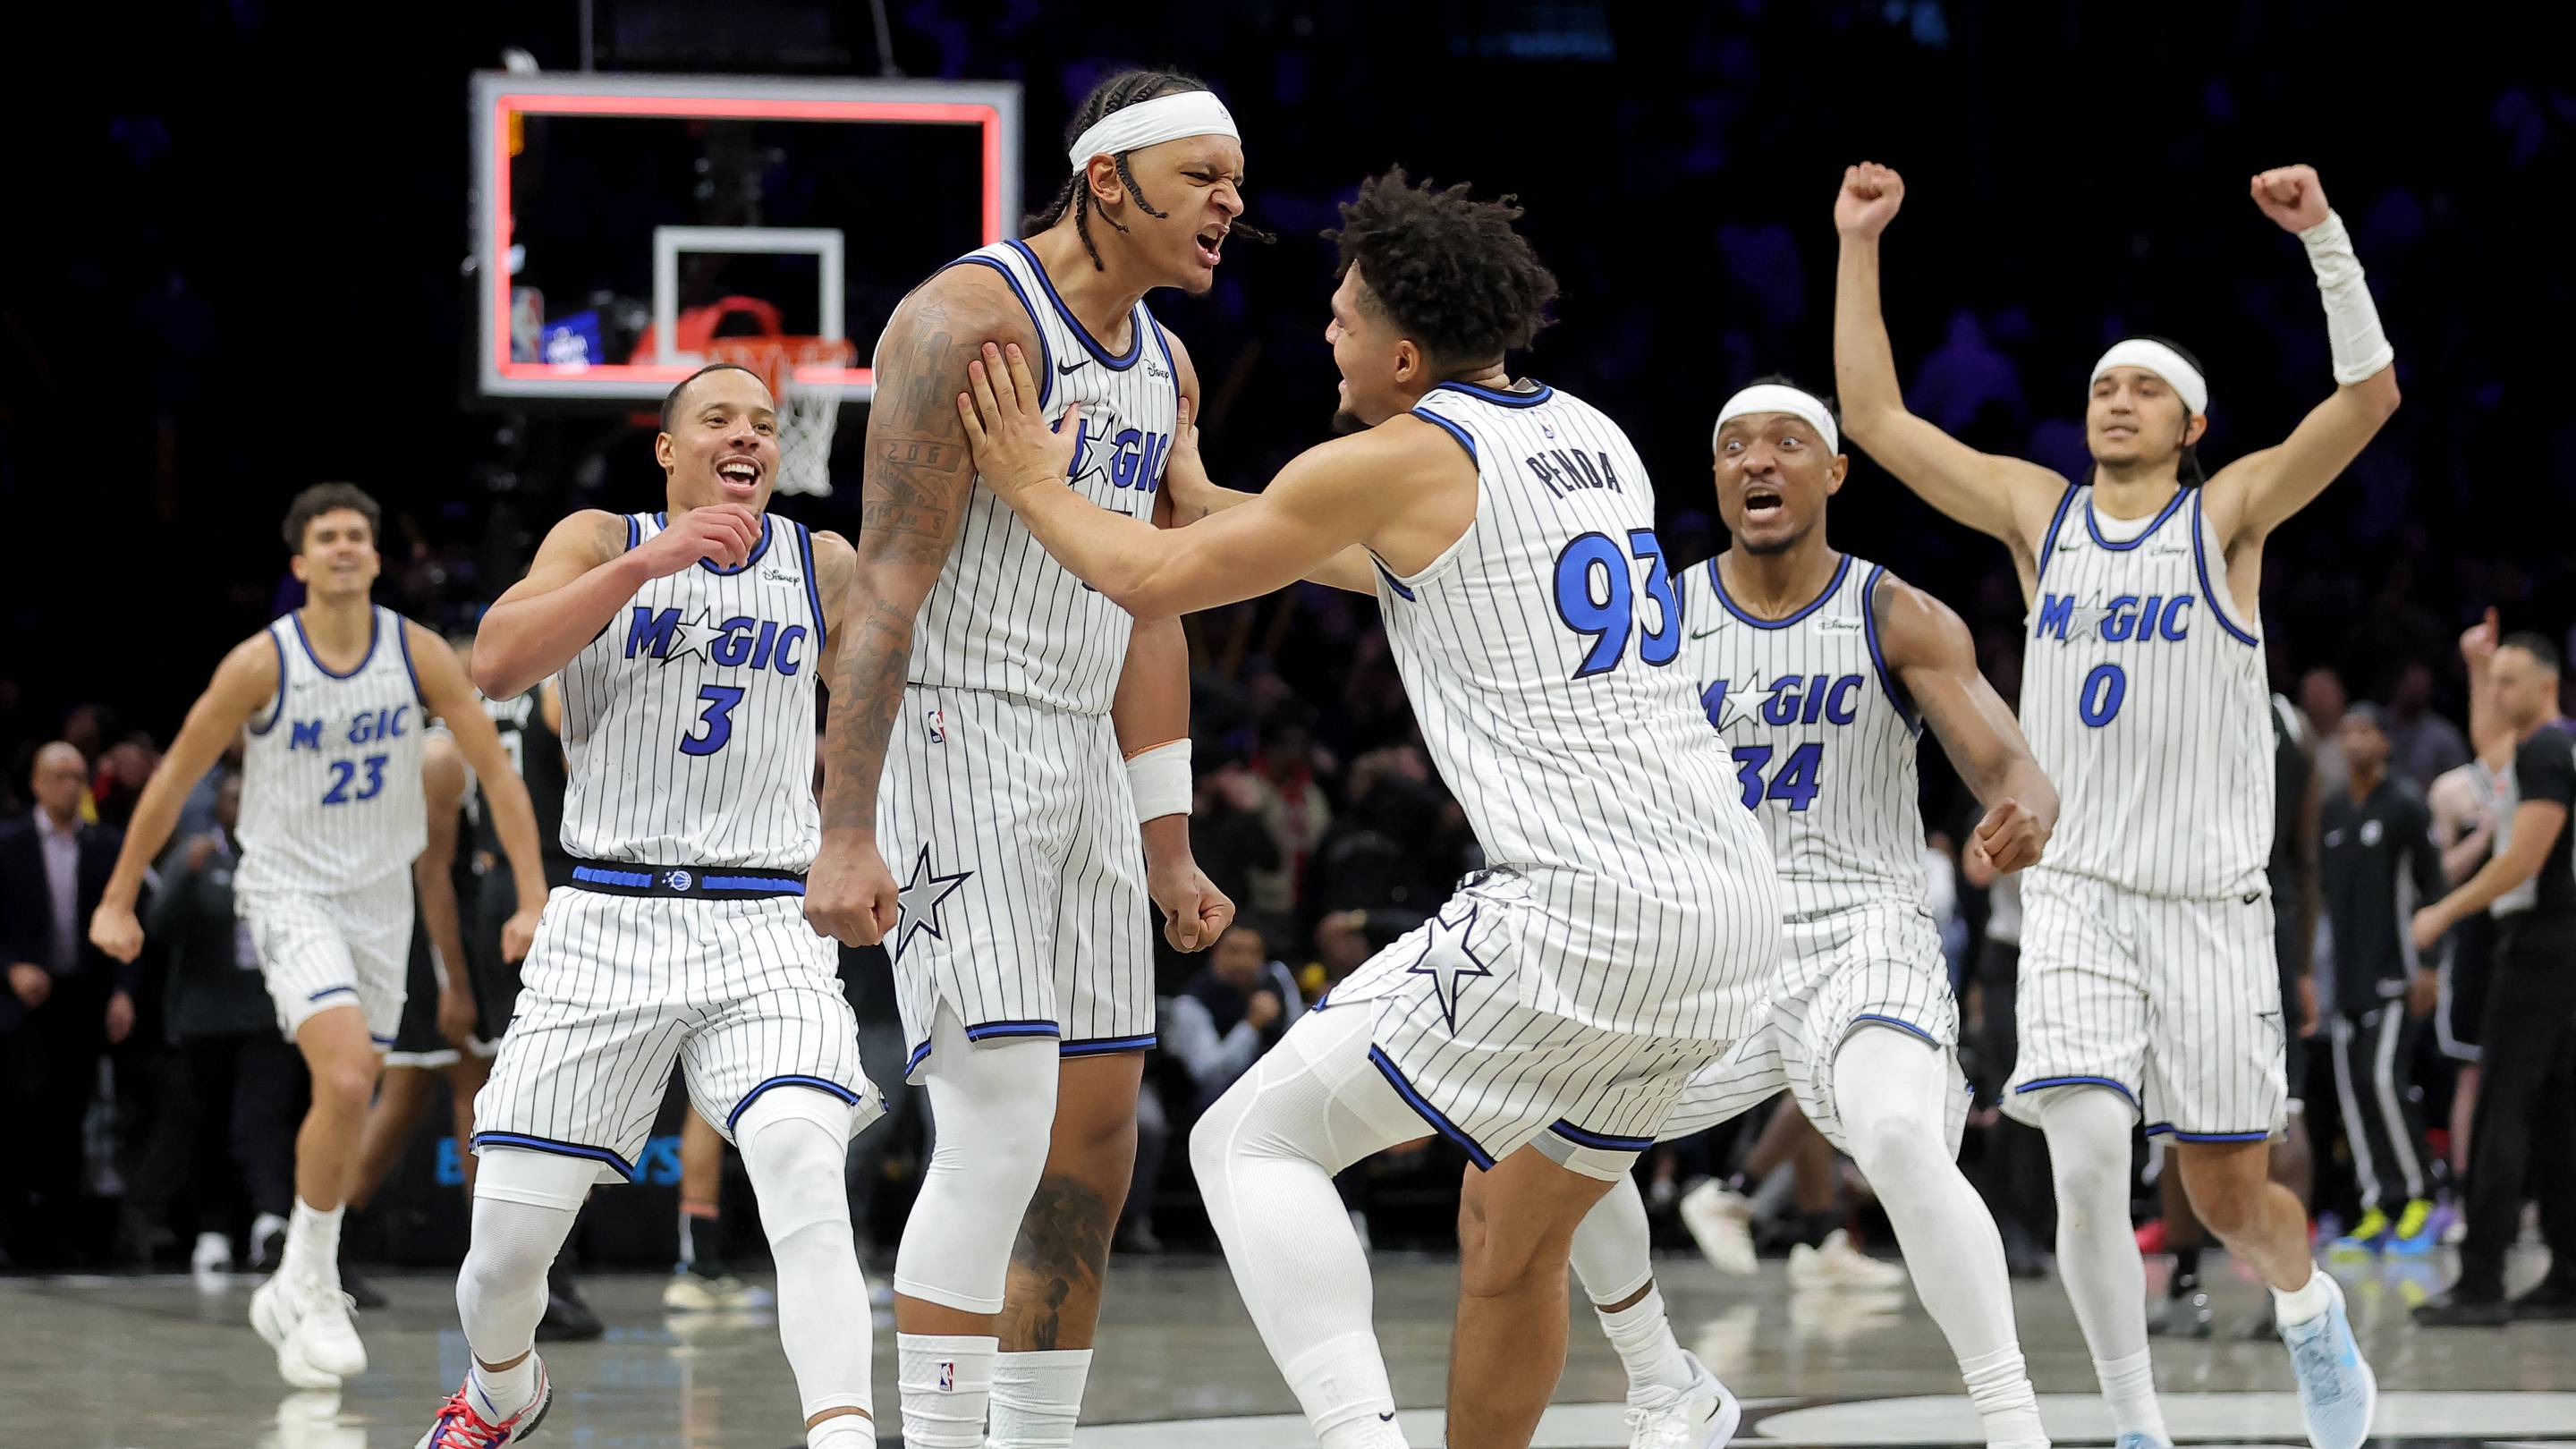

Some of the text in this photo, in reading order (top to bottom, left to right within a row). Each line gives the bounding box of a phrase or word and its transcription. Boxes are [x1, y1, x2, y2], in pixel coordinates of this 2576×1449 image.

[1526, 448, 1623, 499] PENDA
[1554, 528, 1681, 680] 93
[679, 683, 746, 756] 3
[2080, 664, 2126, 728] 0
[322, 755, 388, 805] 23
[1731, 742, 1825, 811] 34
